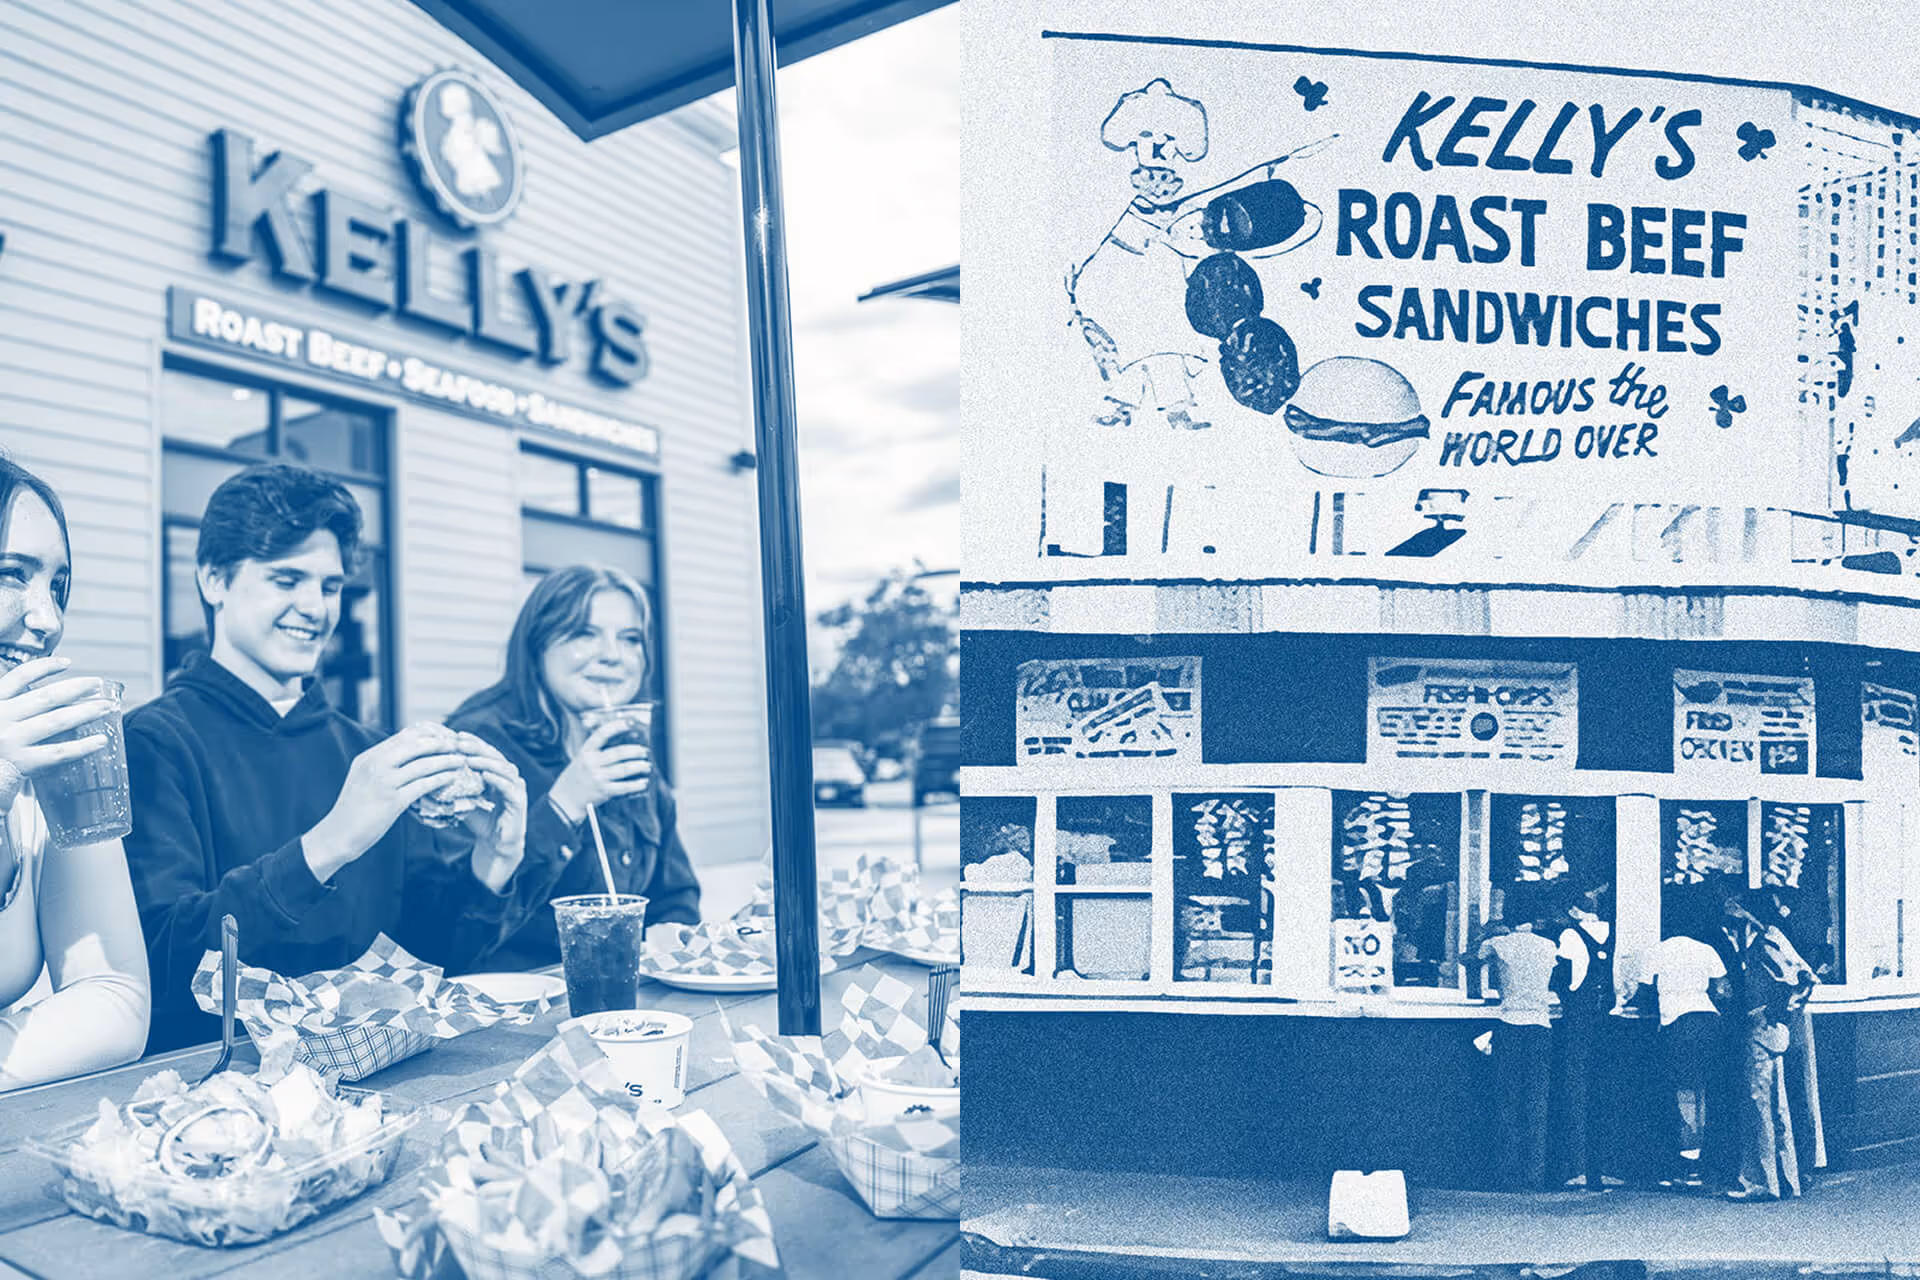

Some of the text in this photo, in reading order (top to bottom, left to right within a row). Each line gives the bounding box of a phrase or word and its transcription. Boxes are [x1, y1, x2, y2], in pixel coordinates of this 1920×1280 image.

[1382, 91, 1701, 180] KELLY'S
[207, 128, 648, 388] KELLY'S
[1336, 189, 1747, 278] ROAST BEEF
[194, 297, 303, 358] ROAST
[307, 329, 387, 380] BEEF
[1355, 285, 1721, 356] SANDWICHES
[1440, 362, 1669, 419] FAMOUS the
[1439, 422, 1658, 467] WORLD OVER
